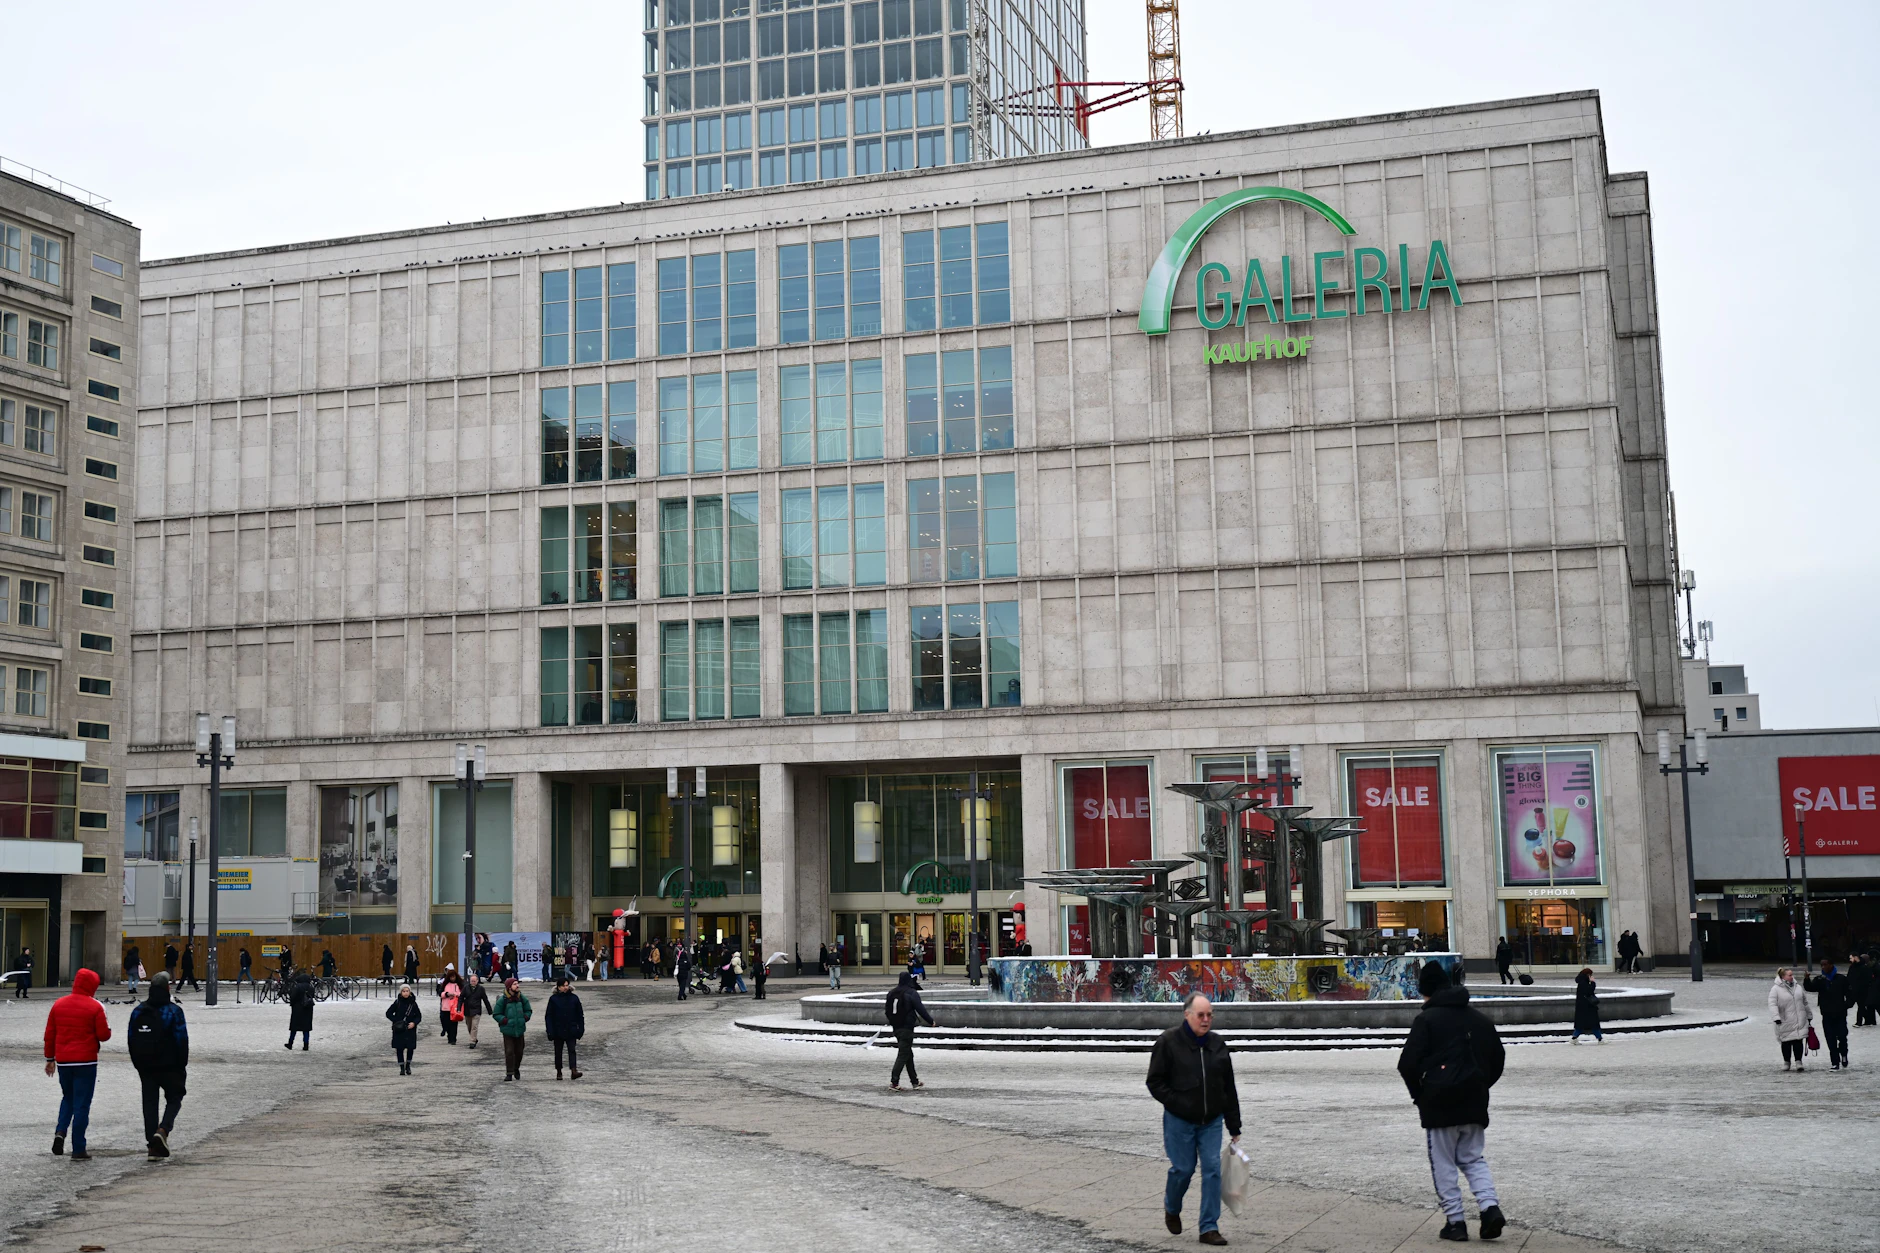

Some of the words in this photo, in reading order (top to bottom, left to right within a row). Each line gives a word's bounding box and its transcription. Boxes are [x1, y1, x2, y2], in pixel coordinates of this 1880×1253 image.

[1195, 239, 1464, 331] GALERIA
[1517, 771, 1541, 782] BIG
[1365, 786, 1430, 807] SALE
[1793, 786, 1877, 811] SALE
[1083, 797, 1149, 819] SALE
[669, 880, 728, 899] GERIA
[915, 876, 972, 895] GALERIA
